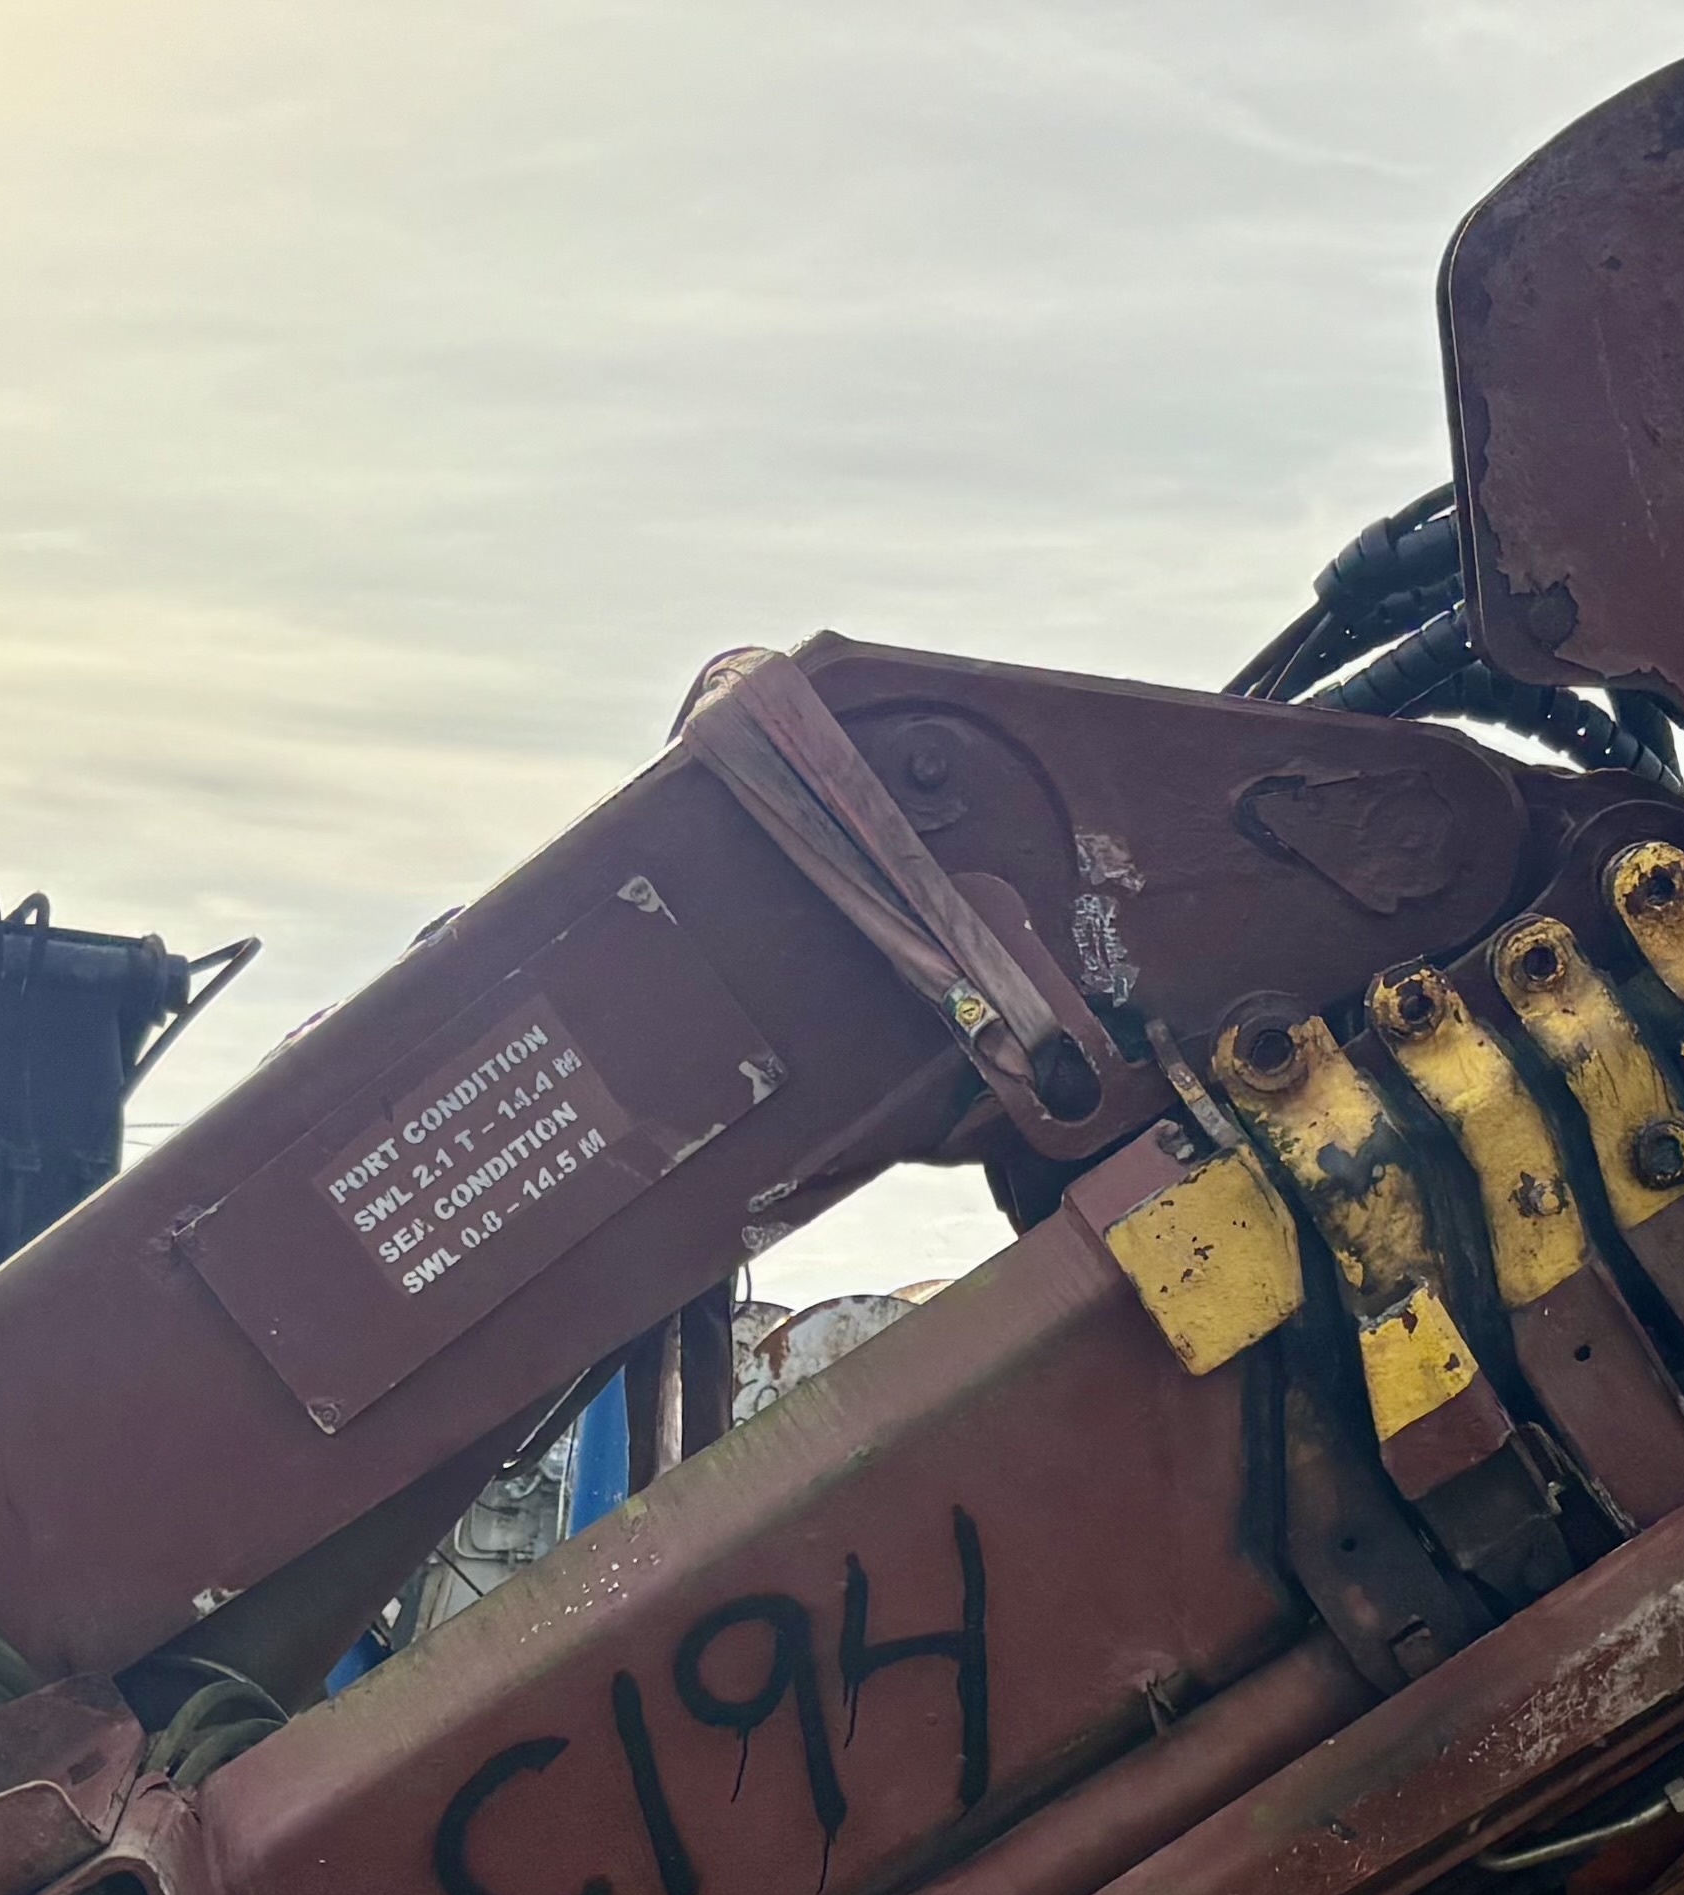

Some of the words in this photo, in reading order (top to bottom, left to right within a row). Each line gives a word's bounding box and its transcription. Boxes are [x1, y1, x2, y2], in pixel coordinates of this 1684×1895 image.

[328, 1137, 400, 1204] PORT
[402, 1024, 549, 1144] CONDITION
[353, 1185, 414, 1232] SWL
[412, 1147, 455, 1189] 2.1
[453, 1128, 475, 1152] T
[378, 1217, 435, 1263] SEA
[433, 1100, 578, 1220] CONDITION
[402, 1247, 462, 1294] SWL
[460, 1210, 503, 1248] 0.8
[521, 1149, 577, 1200] 14.5
[577, 1127, 607, 1159] M
